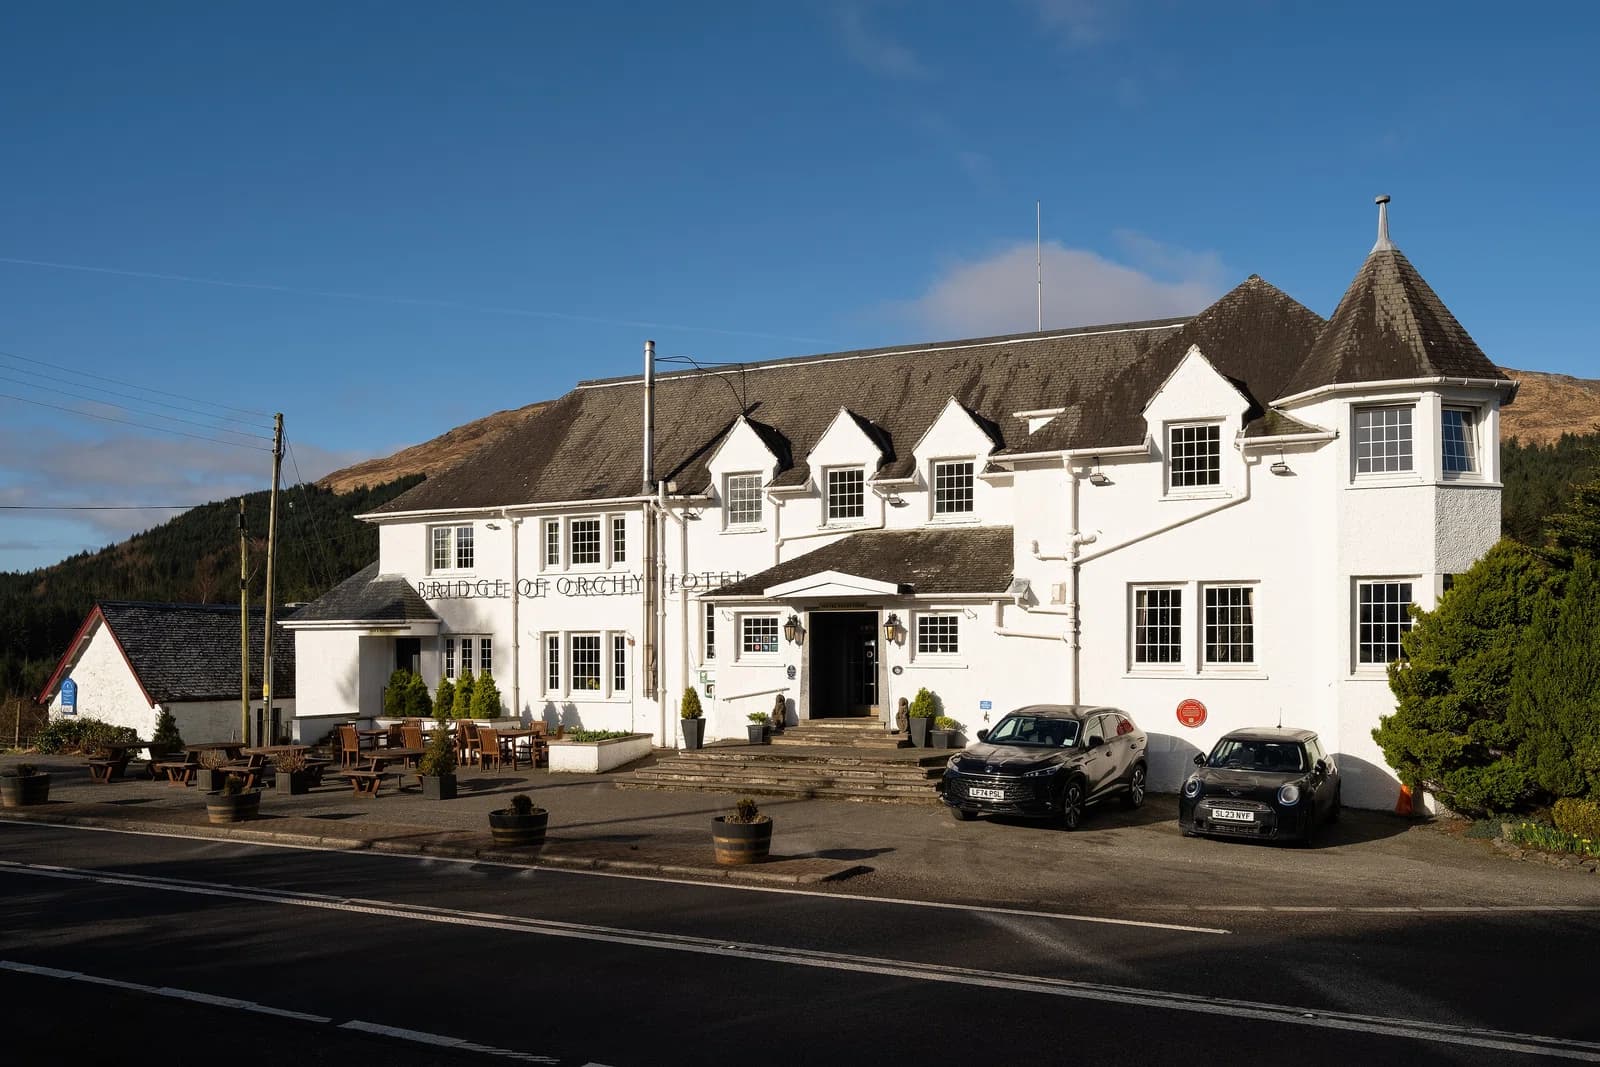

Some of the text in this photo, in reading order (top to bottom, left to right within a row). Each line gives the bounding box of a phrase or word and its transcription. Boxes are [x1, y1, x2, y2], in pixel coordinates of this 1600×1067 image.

[418, 579, 503, 598] BRIDGE
[516, 577, 547, 597] OF
[557, 573, 643, 594] ORCHY
[971, 788, 1002, 798] LF74 PSL
[1215, 810, 1235, 819] SL23
